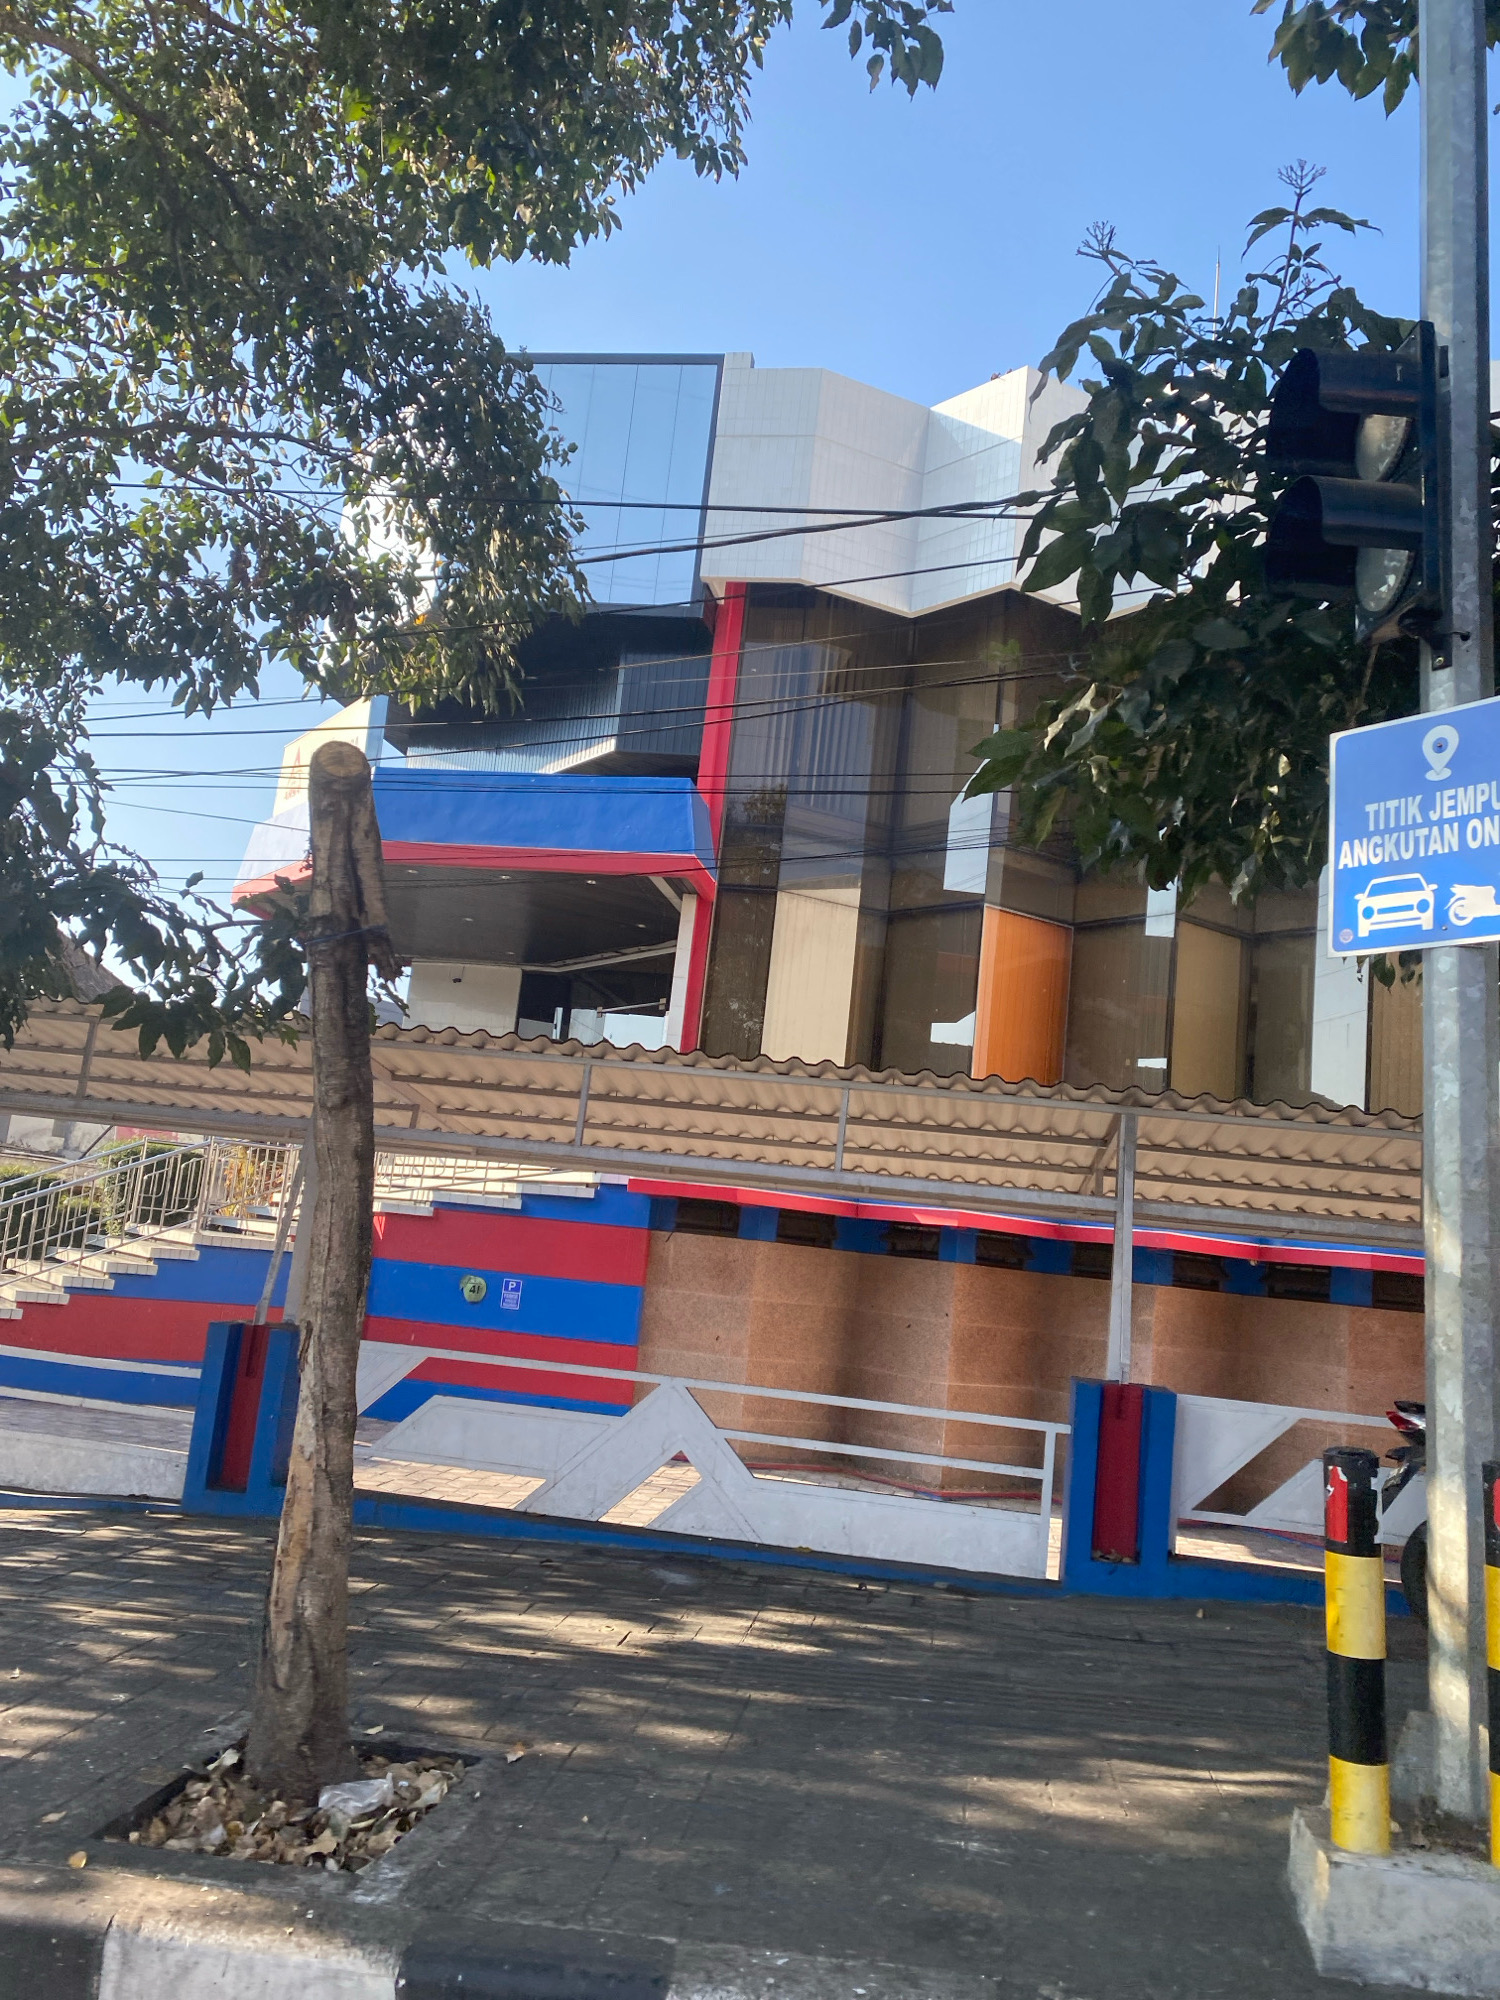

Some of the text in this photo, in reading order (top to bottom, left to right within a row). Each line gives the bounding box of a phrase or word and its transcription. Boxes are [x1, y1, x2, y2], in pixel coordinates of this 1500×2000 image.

[1365, 795, 1423, 831] TITIK
[1338, 815, 1500, 870] ANGKUTAN ON
[508, 1281, 517, 1291] P
